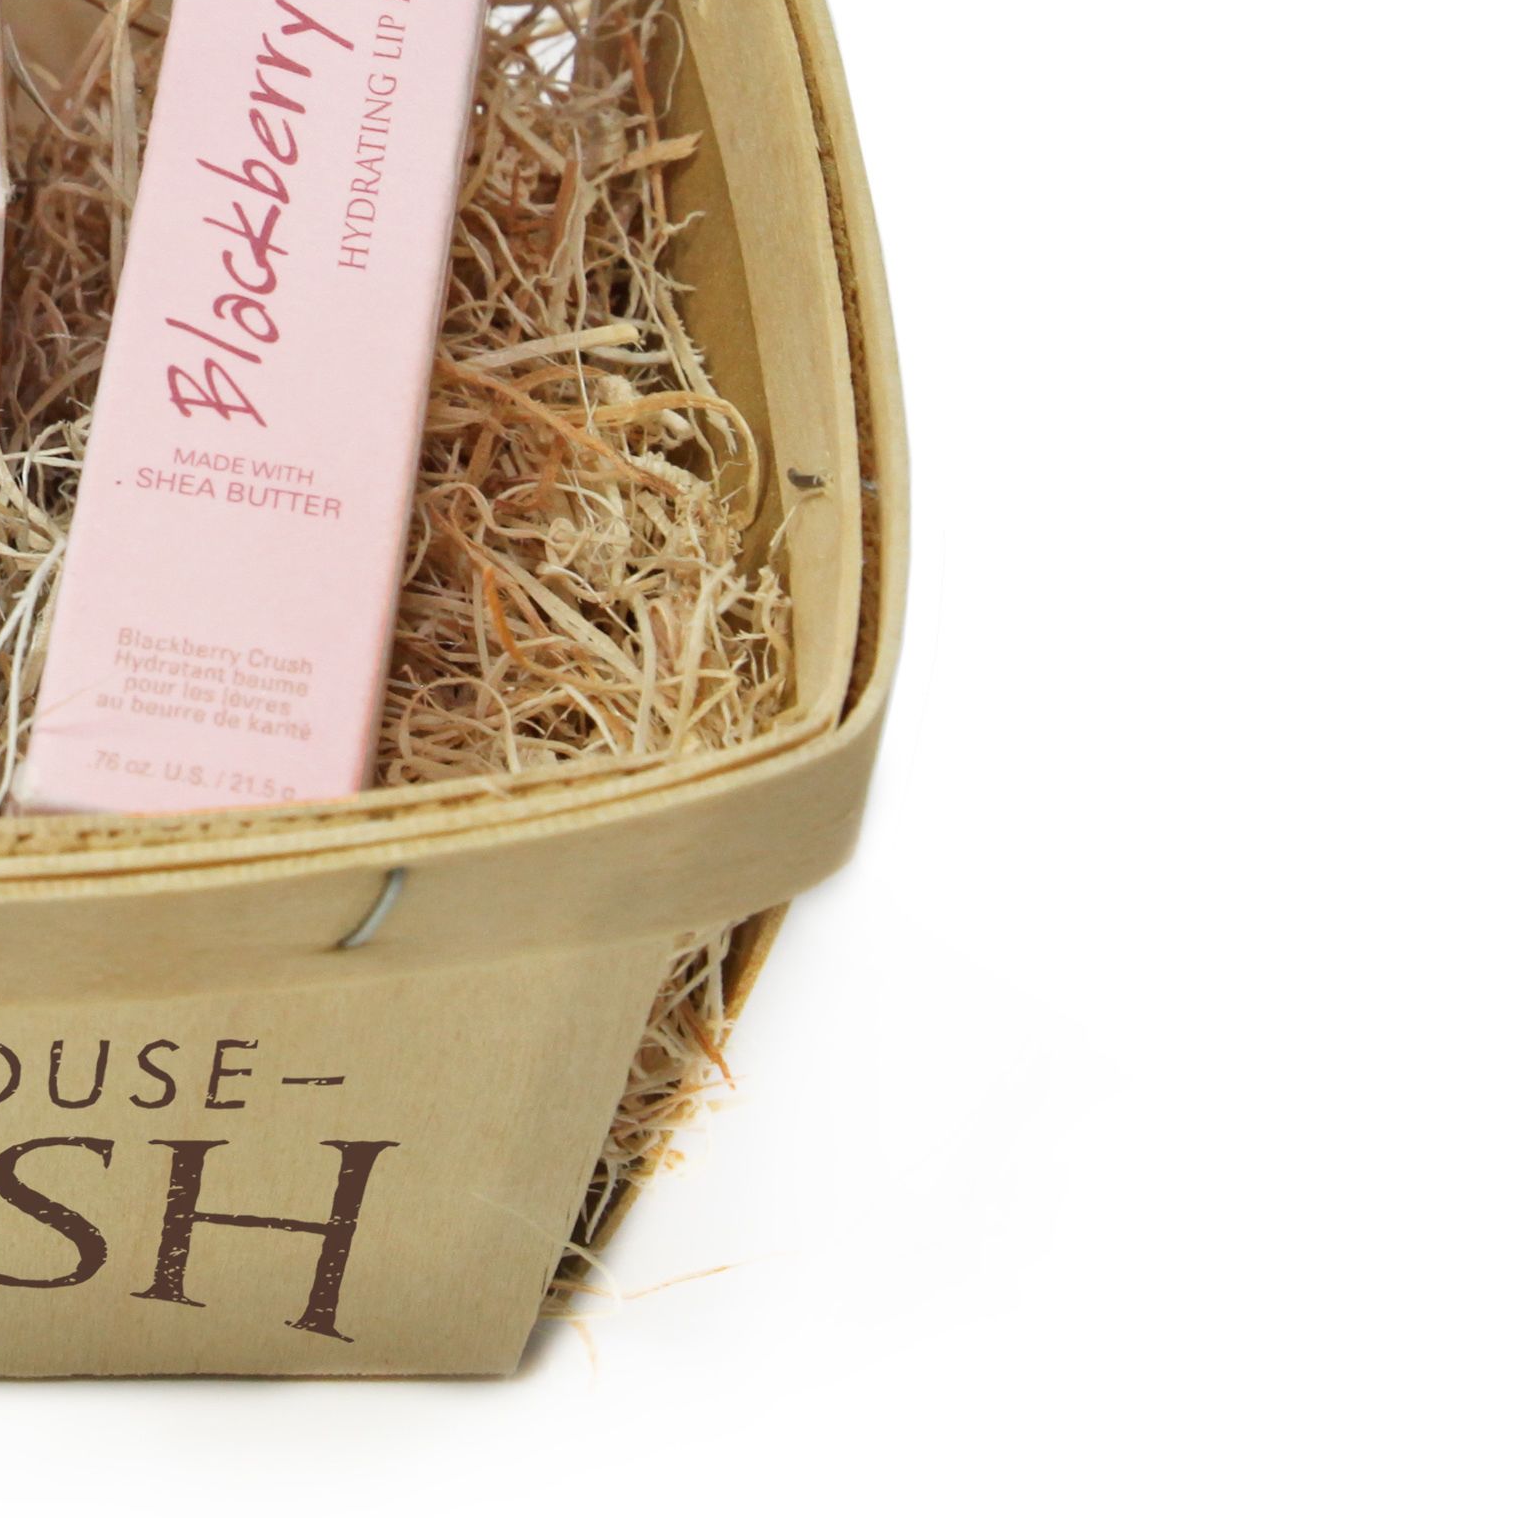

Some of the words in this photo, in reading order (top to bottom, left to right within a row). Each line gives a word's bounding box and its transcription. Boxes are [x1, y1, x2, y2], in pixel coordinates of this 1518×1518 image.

[336, 73, 399, 273] HYDRATING
[373, 13, 408, 59] LIP
[173, 448, 246, 475] MADE
[251, 460, 315, 484] WITH
[136, 467, 217, 499] SHEA
[226, 482, 343, 518] BUTTER
[114, 650, 226, 684] Hydratant
[233, 670, 310, 698] baume
[117, 628, 243, 664] Blackberry
[247, 648, 314, 676] Crush
[95, 693, 123, 711] au
[131, 697, 207, 724] beurre
[213, 711, 241, 729] de
[123, 676, 177, 695] pour
[183, 683, 215, 704] les
